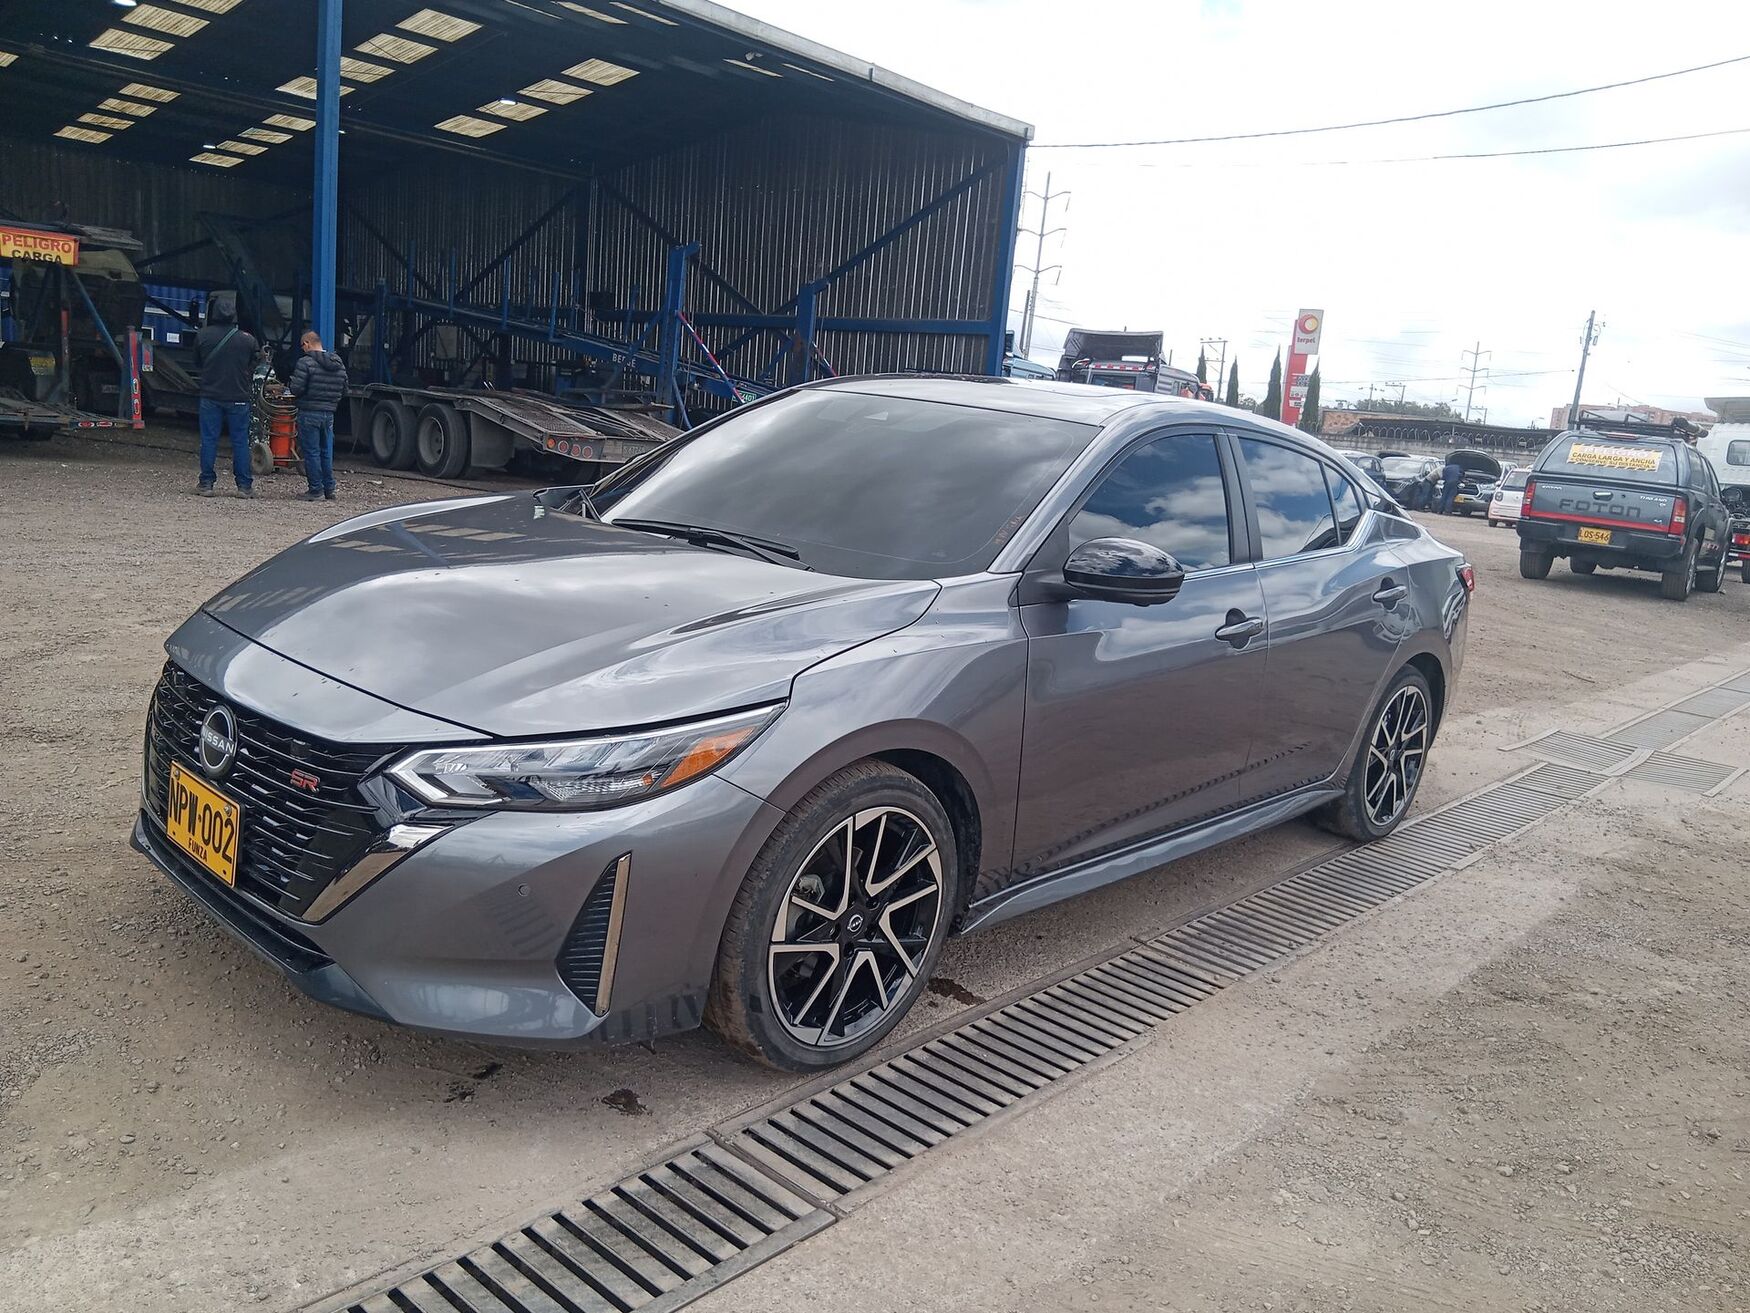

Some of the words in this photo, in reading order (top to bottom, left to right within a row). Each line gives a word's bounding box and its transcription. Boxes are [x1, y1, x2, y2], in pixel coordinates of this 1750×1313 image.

[1, 233, 73, 254] PELIGRO
[11, 249, 63, 264] CARGA
[1572, 451, 1597, 460] CARGA
[1598, 454, 1623, 462] LARGA
[1618, 461, 1650, 469] DISTANCIA
[1559, 498, 1641, 518] FOTON
[201, 727, 235, 753] NISSAN
[290, 768, 320, 793] SR
[188, 837, 209, 862] FUNZA
